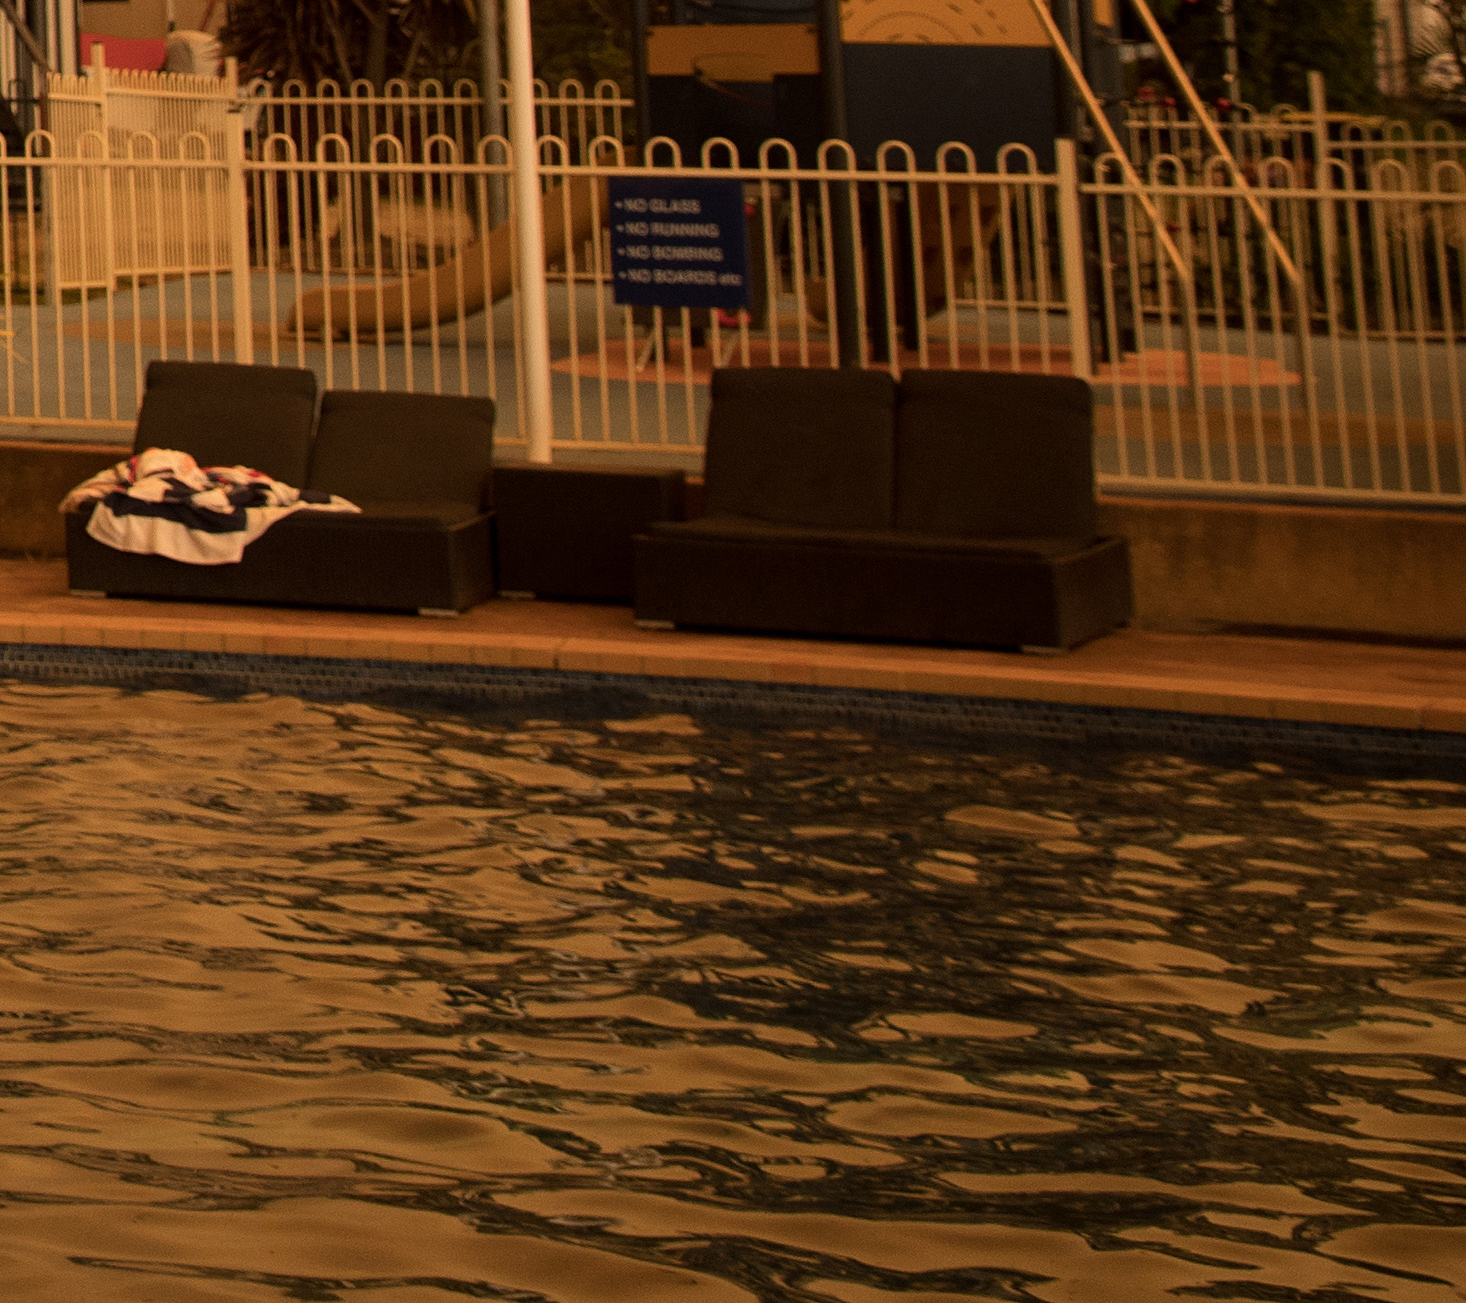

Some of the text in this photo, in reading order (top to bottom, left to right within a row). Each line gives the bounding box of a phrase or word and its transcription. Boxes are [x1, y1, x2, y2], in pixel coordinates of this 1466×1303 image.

[624, 199, 701, 214] NO GLASS
[625, 222, 719, 238] NO RUNNING
[626, 245, 724, 261] NO BOMBING
[627, 269, 651, 284] NO
[653, 270, 717, 285] BOARDS
